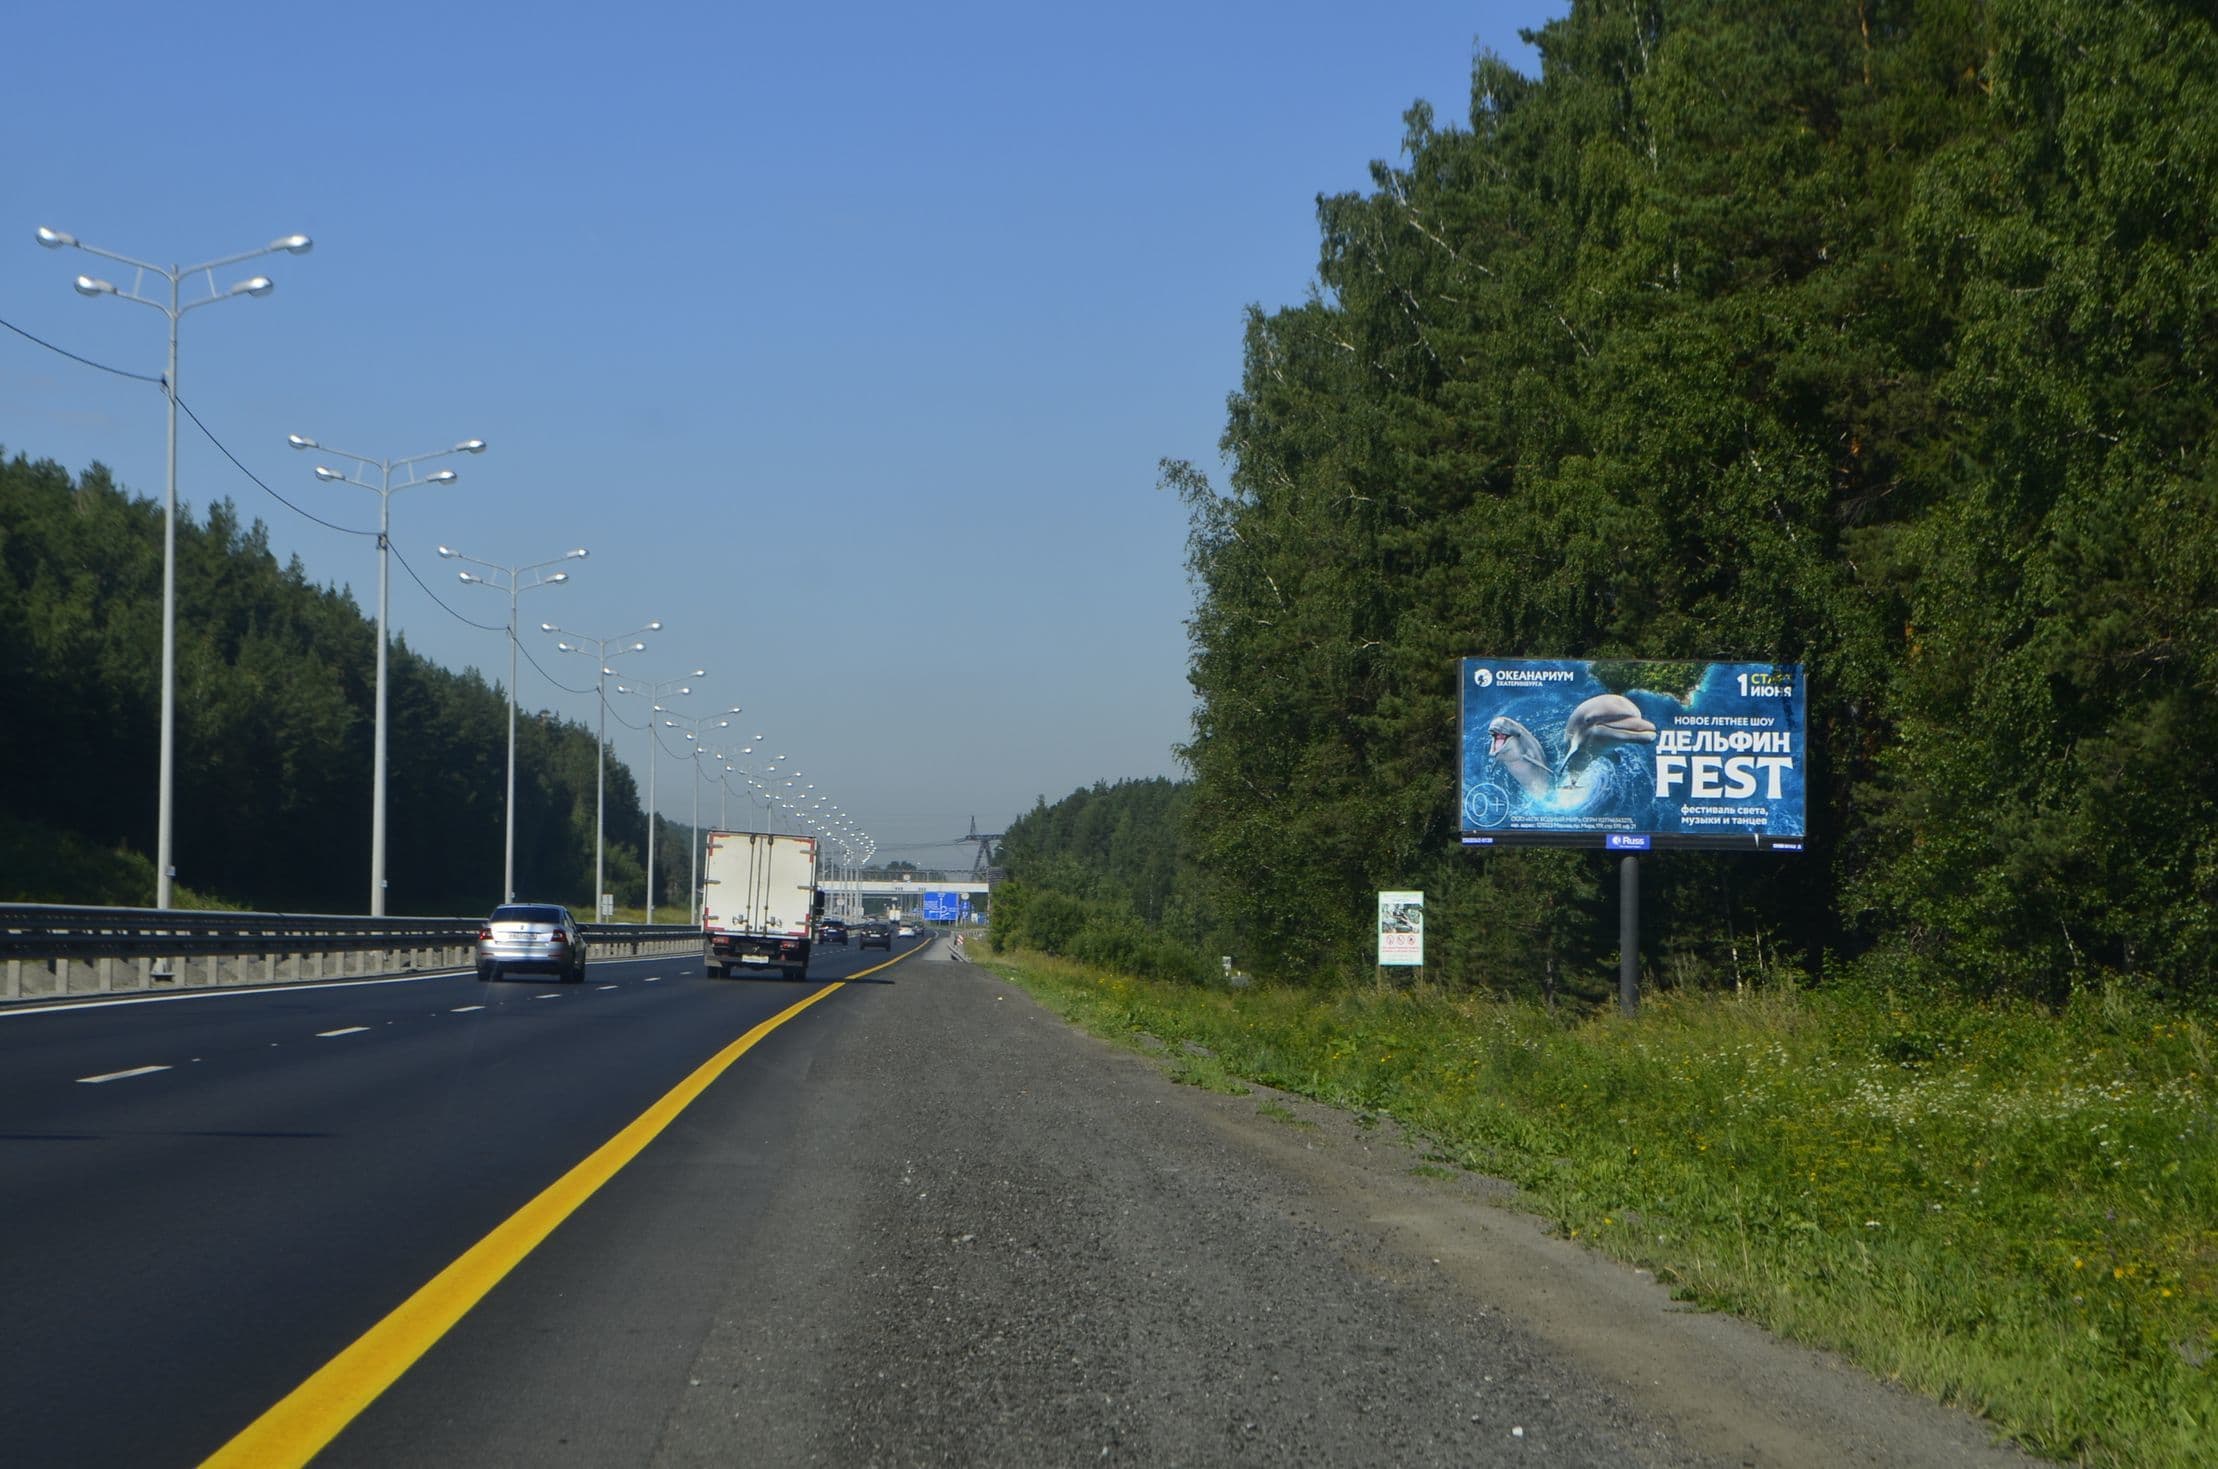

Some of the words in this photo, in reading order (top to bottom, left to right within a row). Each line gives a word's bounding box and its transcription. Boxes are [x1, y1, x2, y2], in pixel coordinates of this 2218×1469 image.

[1496, 670, 1574, 681] ОКЕАНАРИУМ
[1737, 673, 1748, 696] 1
[1750, 686, 1792, 697] ИЮНЯ
[1674, 716, 1710, 726] НОВОЕ
[1710, 717, 1748, 726] ЛЕТНЕЕ
[1750, 718, 1774, 726] ШОУ
[1656, 730, 1792, 754] ДЕЛЬФИН
[1656, 756, 1794, 799] FEST
[1472, 792, 1506, 817] 0+
[1680, 804, 1736, 816] фестиваль
[1737, 806, 1768, 816] света,
[1681, 816, 1720, 826] музыки
[1732, 817, 1767, 826] танцев
